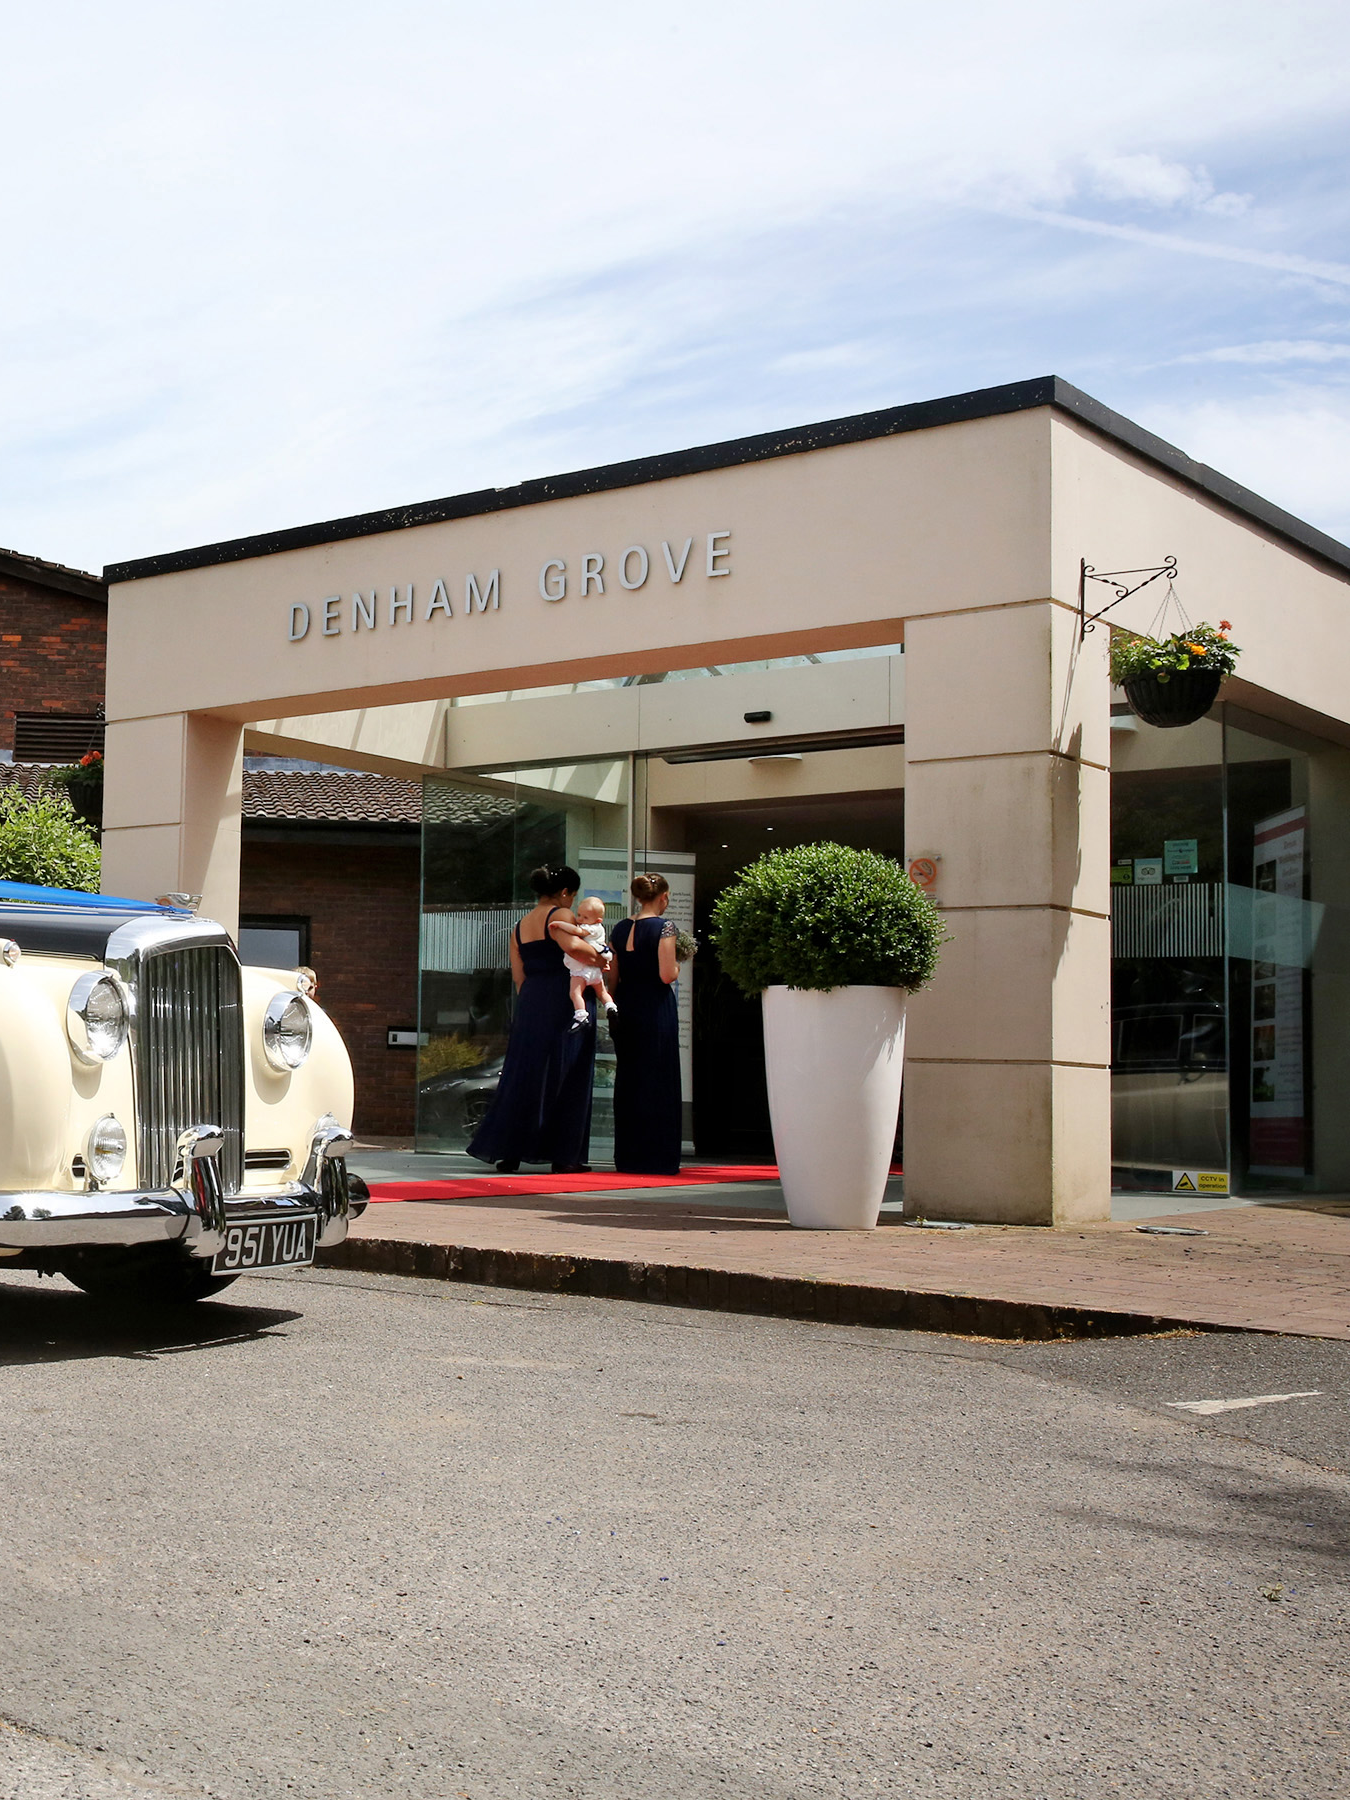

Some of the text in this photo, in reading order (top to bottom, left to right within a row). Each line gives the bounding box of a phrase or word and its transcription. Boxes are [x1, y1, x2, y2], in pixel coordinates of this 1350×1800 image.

[288, 530, 731, 642] DENHAM GROVE
[224, 1222, 307, 1268] 951 YUA
